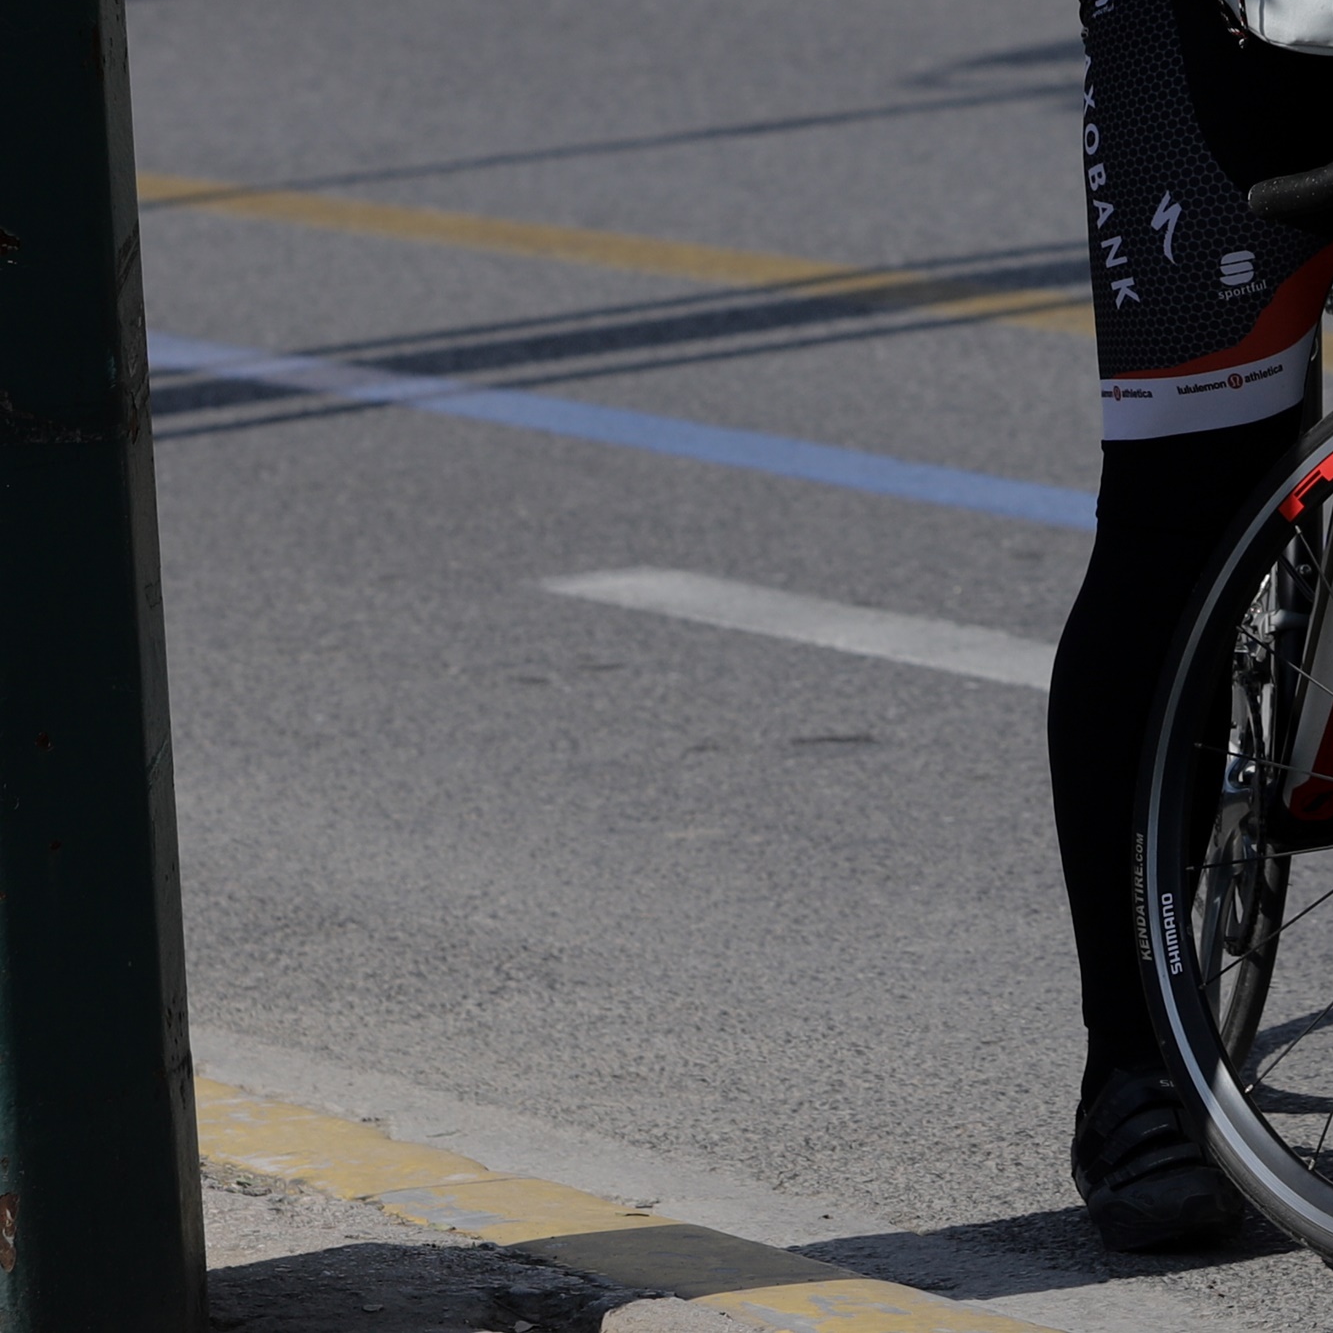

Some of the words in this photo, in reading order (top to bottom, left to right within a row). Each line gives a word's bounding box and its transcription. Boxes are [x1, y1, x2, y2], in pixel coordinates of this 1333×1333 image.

[1218, 280, 1267, 301] sportful
[1177, 380, 1227, 395] lululemon
[1245, 364, 1284, 383] athletica
[1133, 832, 1153, 961] KENDATIRE.COM
[1161, 892, 1183, 975] SHIMANO
